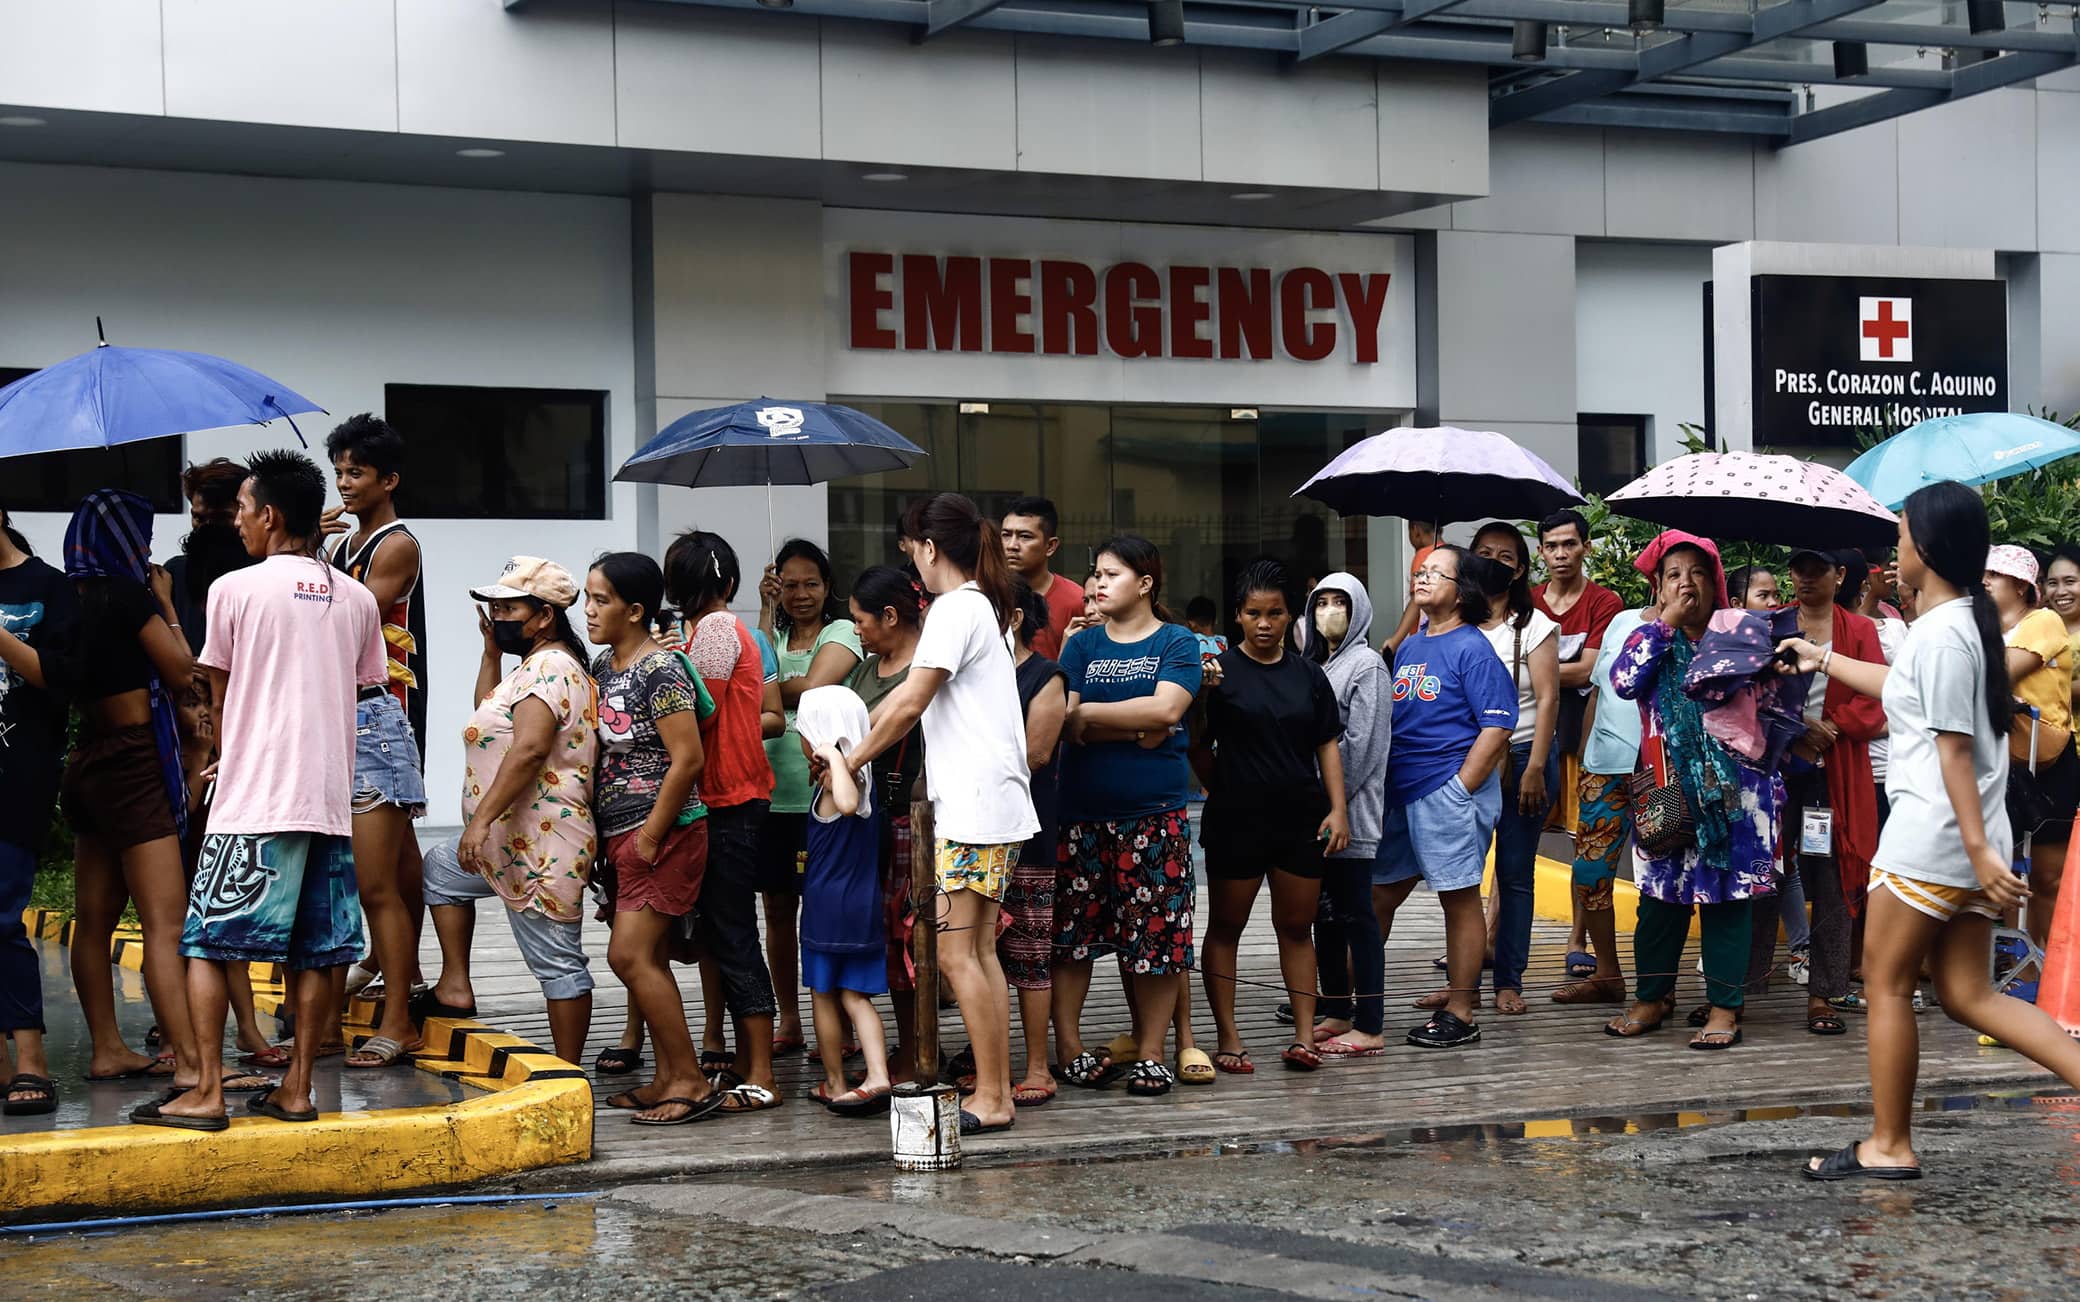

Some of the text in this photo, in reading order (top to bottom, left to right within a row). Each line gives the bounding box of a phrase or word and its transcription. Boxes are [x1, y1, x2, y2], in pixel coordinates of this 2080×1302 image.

[849, 251, 1391, 363] EMERGENCY
[1775, 369, 1996, 396] PRES. CORAZON C. AQUINO
[1808, 401, 1882, 426] GENERAL
[294, 593, 332, 602] PRINTING
[1085, 656, 1160, 678] GUESS
